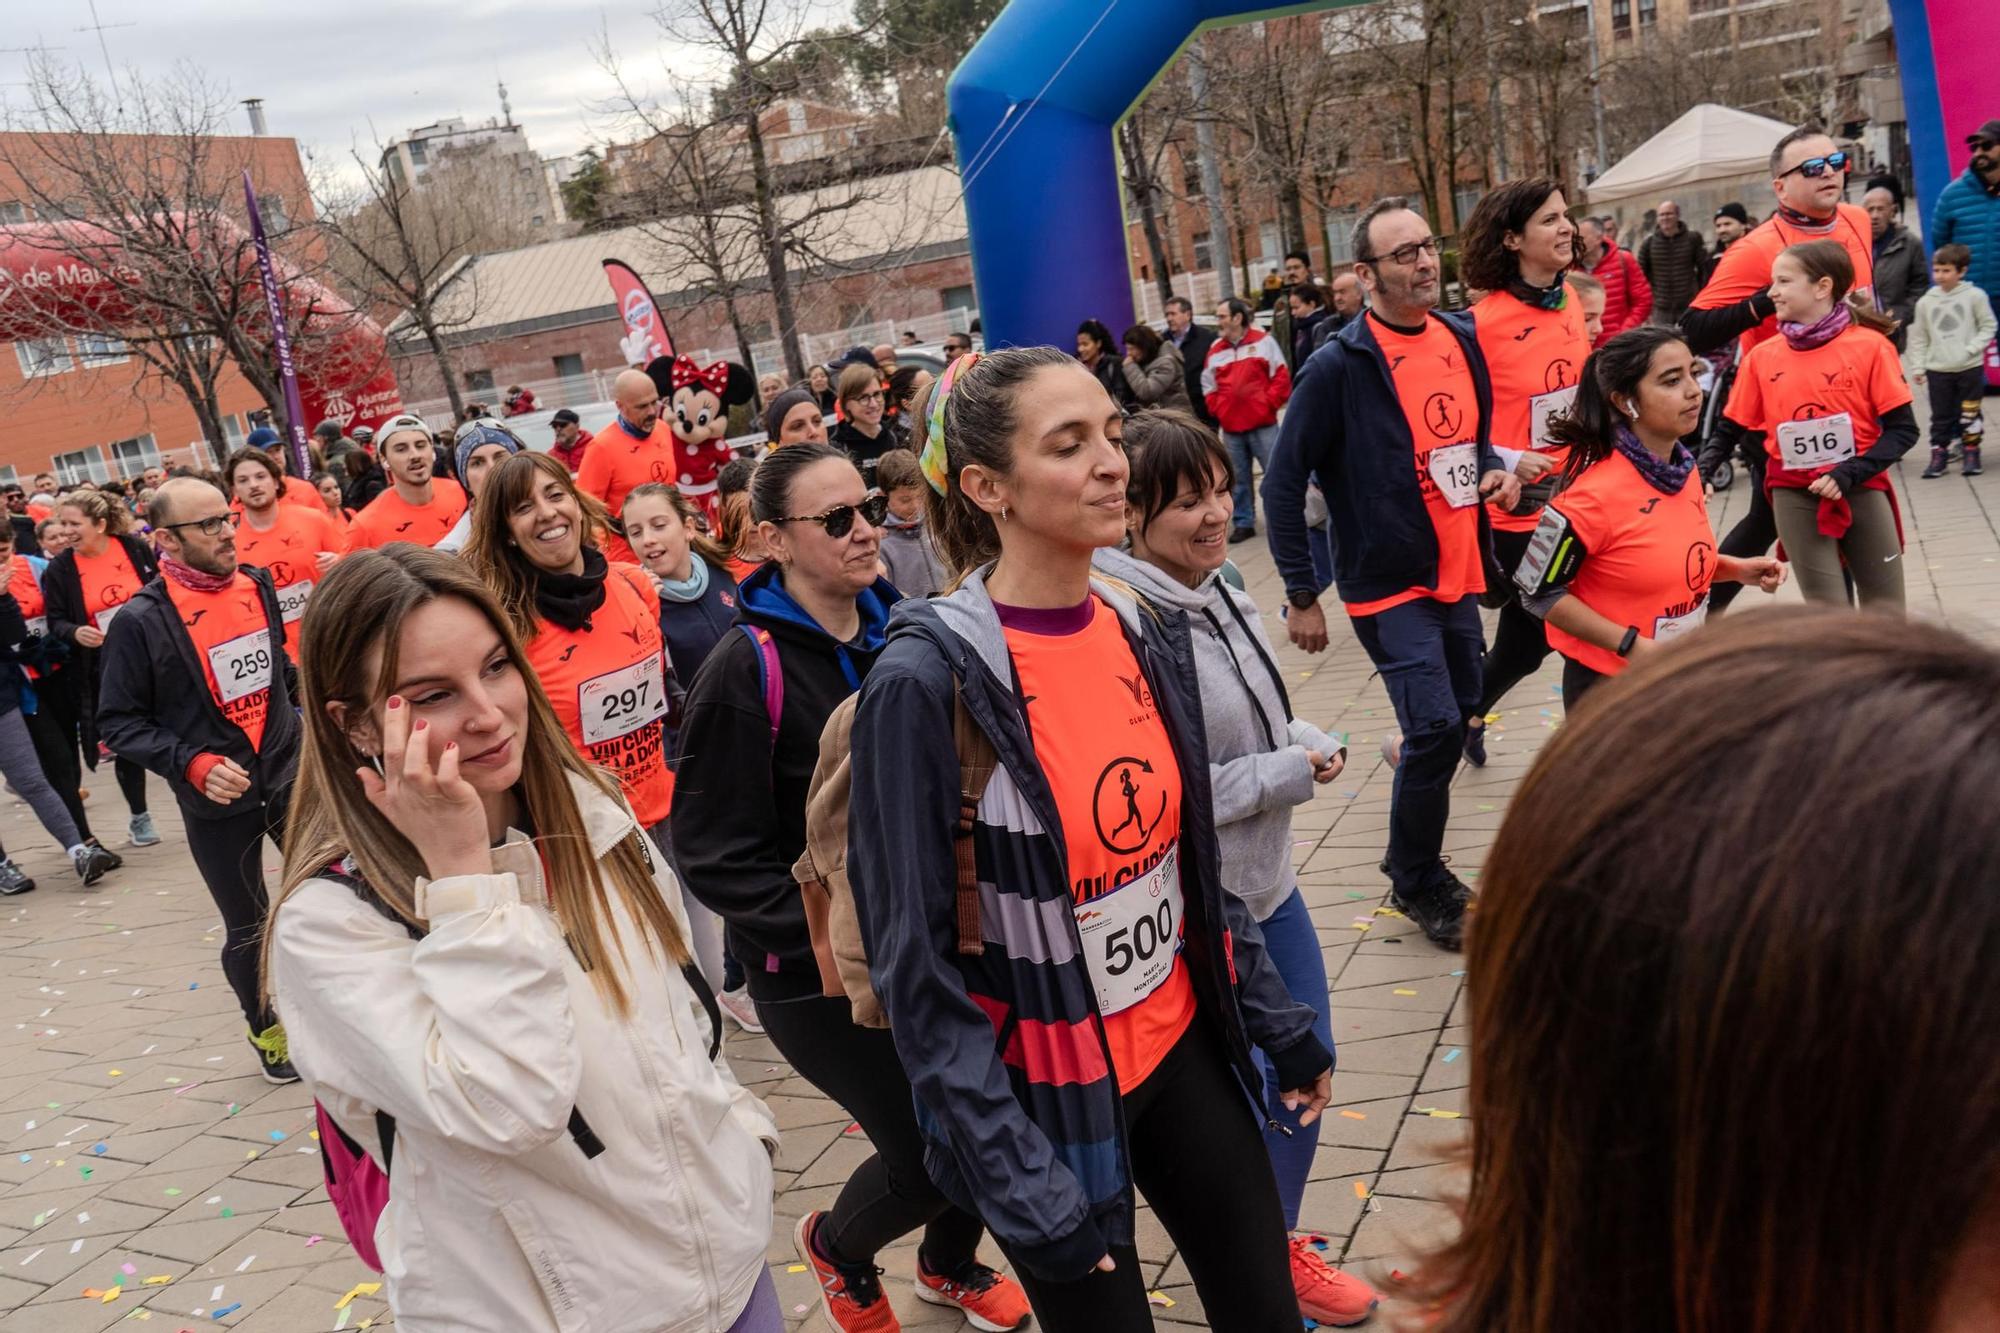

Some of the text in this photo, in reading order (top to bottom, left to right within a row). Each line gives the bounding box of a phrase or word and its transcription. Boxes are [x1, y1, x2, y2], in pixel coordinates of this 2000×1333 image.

[22, 266, 52, 288] de
[1793, 432, 1838, 455] 516
[1447, 463, 1477, 489] 136
[278, 593, 306, 613] 284
[231, 649, 270, 680] 259
[602, 680, 649, 721] 297
[1104, 897, 1173, 977] 500
